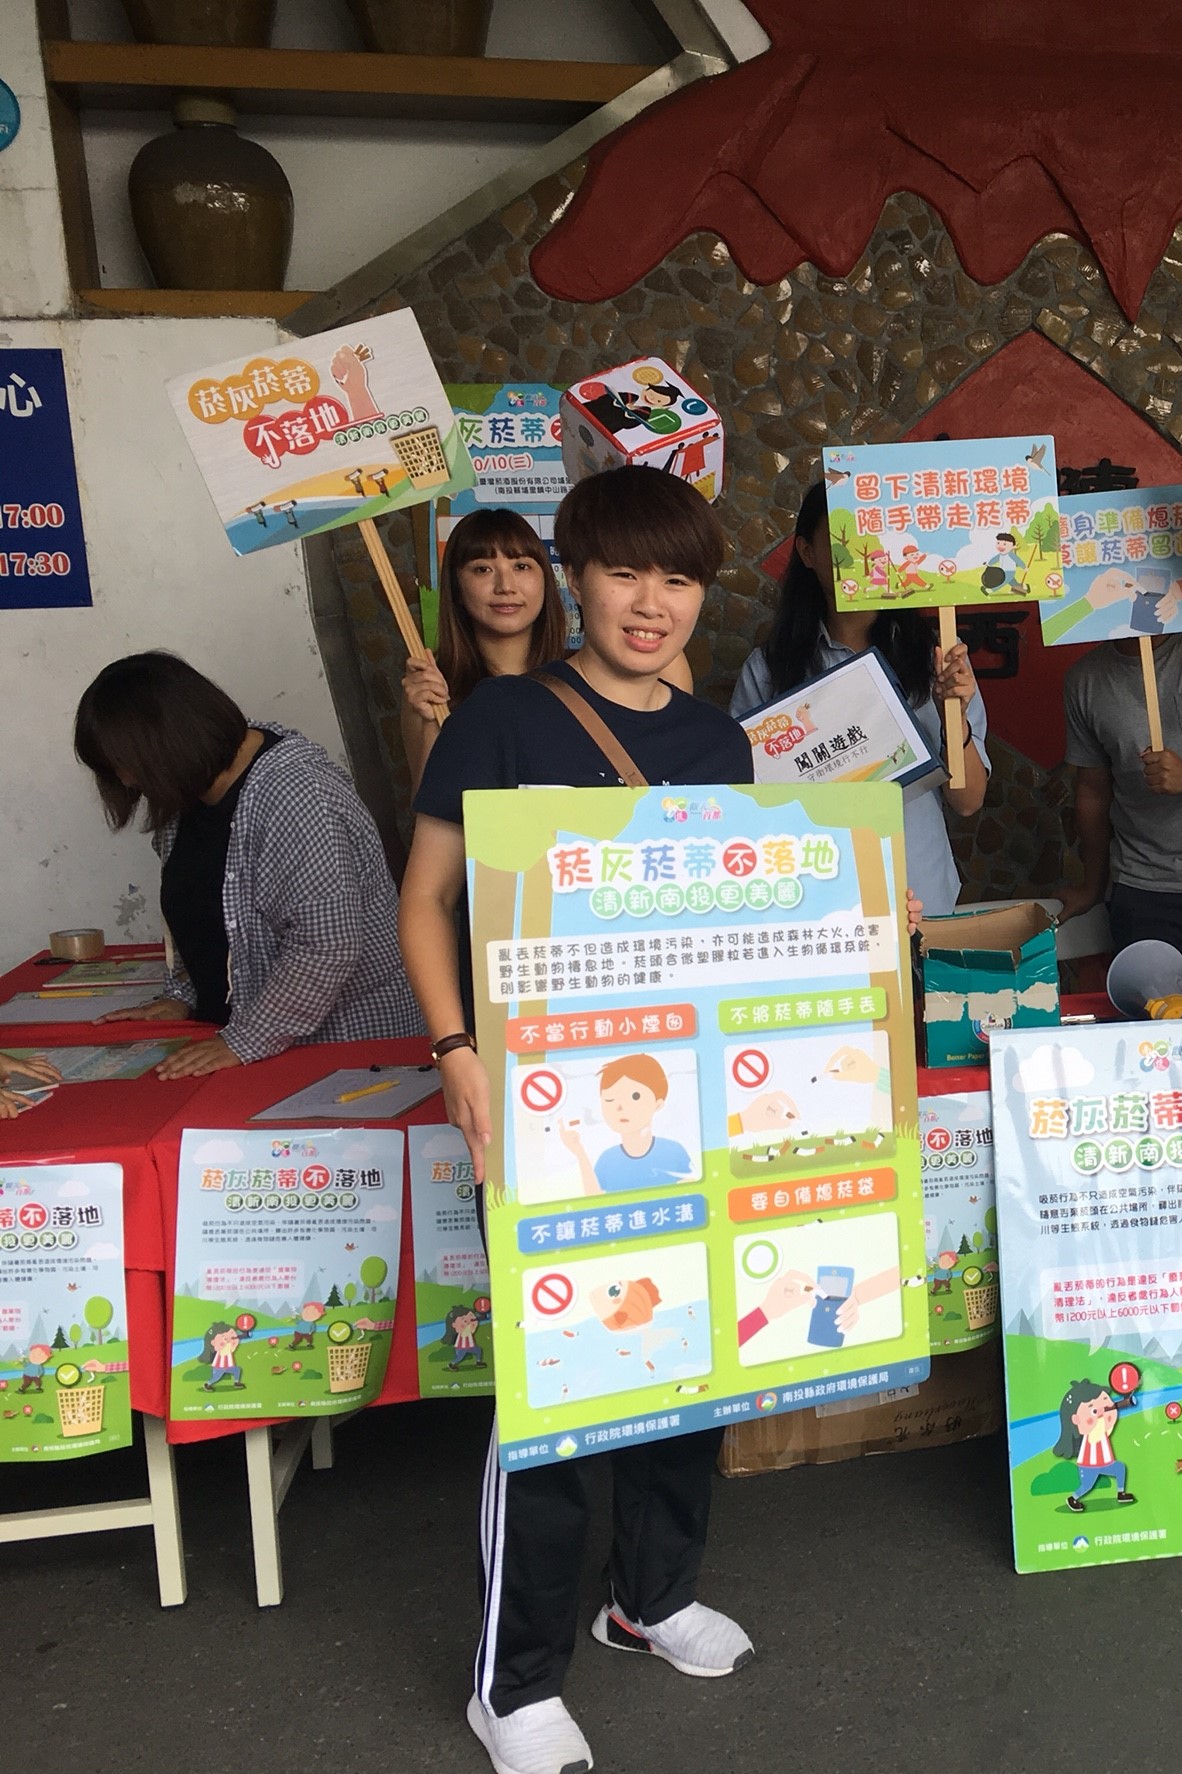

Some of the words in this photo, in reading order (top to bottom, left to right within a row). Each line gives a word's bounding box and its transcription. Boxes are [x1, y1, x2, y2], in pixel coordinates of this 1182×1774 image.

[0, 372, 43, 417] 心
[194, 364, 313, 419] 菸灰菸蒂
[248, 401, 341, 468] 不落地
[856, 466, 1030, 500] 留下清新環境
[0, 503, 64, 527] 7:00
[857, 499, 1031, 534] 隨手帶走菸蒂
[767, 726, 802, 758] 不落地
[794, 725, 869, 772] 闖關遊戲
[552, 838, 836, 887] 菸灰菸蒂不落地
[594, 878, 801, 914] 清新南投更美麗
[519, 1011, 684, 1046] 不當行動小煙囪
[730, 996, 876, 1026] 不將菸蒂隨手丟
[920, 1127, 994, 1149] 不落地
[201, 1168, 383, 1190] 菸灰菸蒂不落地
[751, 1177, 875, 1211] 要自備熄菸袋
[530, 1203, 696, 1244] 不讓菸蒂進水溝
[713, 1401, 751, 1418] 主辦單位
[782, 1371, 890, 1404] 南投縣政府環境保護局
[508, 1444, 549, 1462] 指導單位
[585, 1414, 681, 1446] 行政院環境保護署
